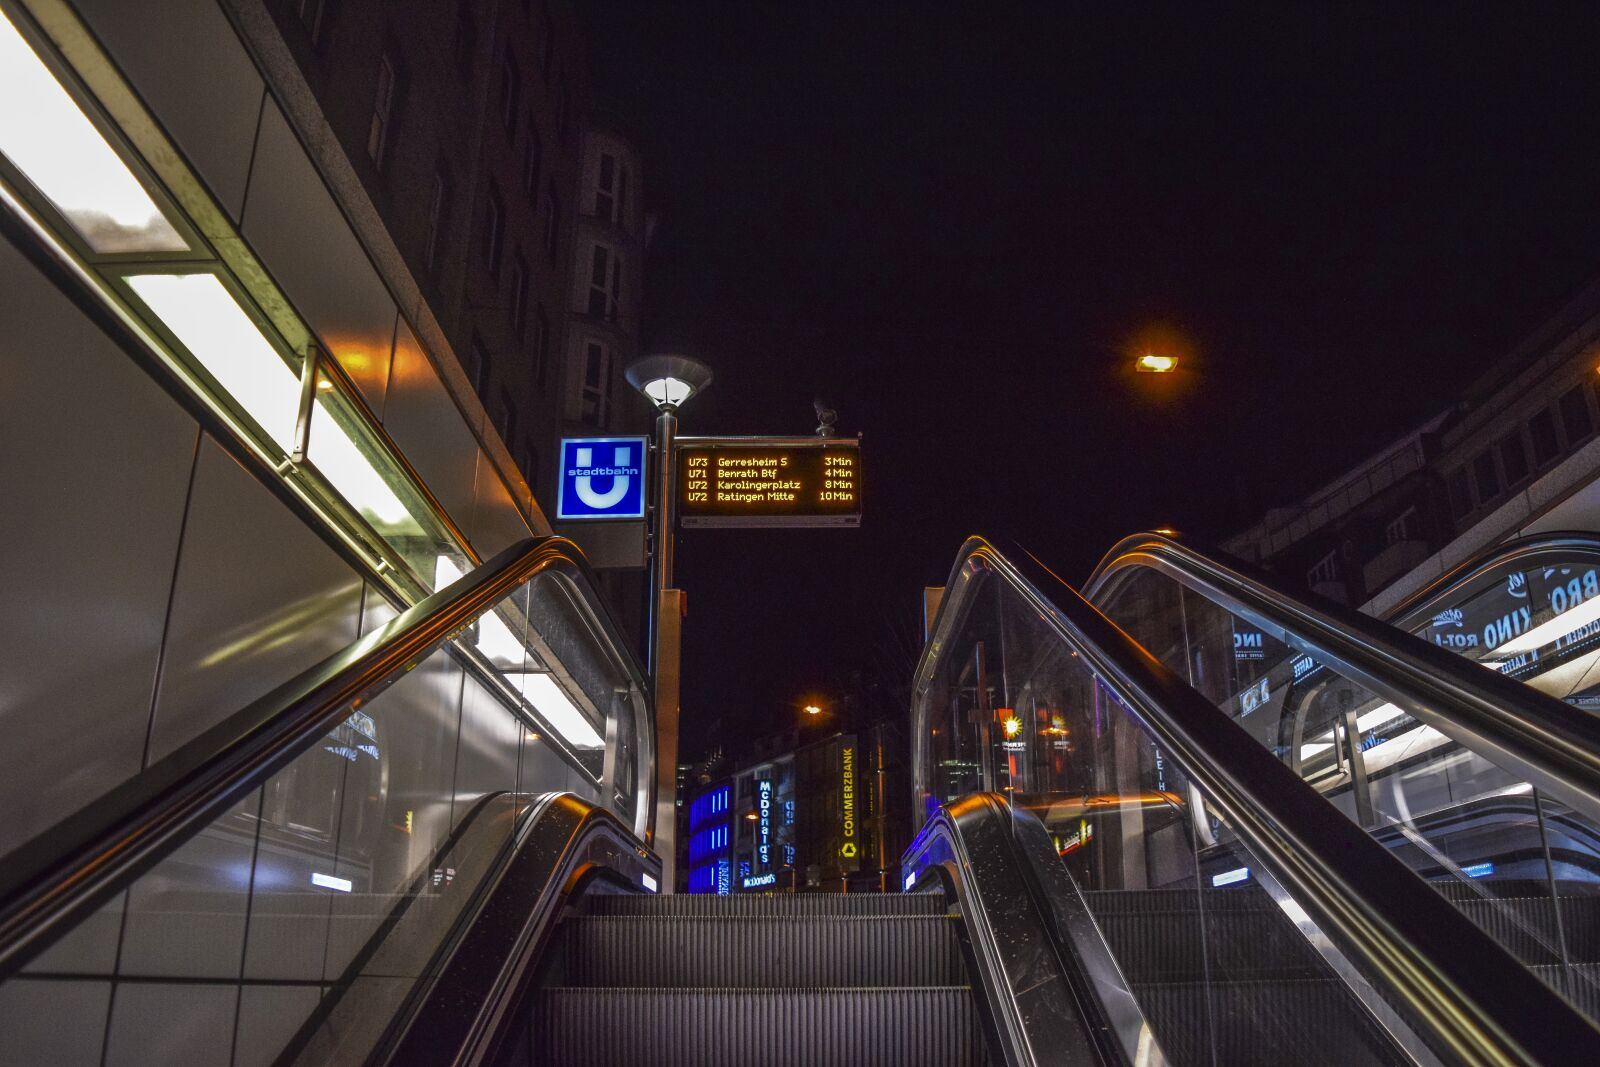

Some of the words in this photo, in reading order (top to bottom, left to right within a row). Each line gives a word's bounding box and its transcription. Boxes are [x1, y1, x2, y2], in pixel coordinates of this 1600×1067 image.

[689, 458, 708, 467] U73
[718, 457, 778, 467] Gerresheim
[780, 458, 788, 467] S
[824, 457, 832, 466] 3
[833, 457, 852, 466] Min
[568, 466, 639, 476] stadtbahn
[688, 469, 707, 478] U71
[718, 469, 758, 478] Benrath
[761, 469, 778, 479] Btf
[825, 468, 832, 477] 4
[833, 468, 852, 477] Min
[575, 447, 630, 509] U
[688, 481, 708, 489] U72
[717, 480, 801, 491] Karolingerplatz
[825, 480, 832, 489] 8
[833, 480, 853, 489] Min
[688, 492, 708, 501] U72
[717, 492, 764, 502] Ratingen
[767, 492, 795, 501] Mitte
[820, 491, 832, 501] 10
[833, 491, 853, 501] Min
[843, 747, 854, 838] COMMERZBANK
